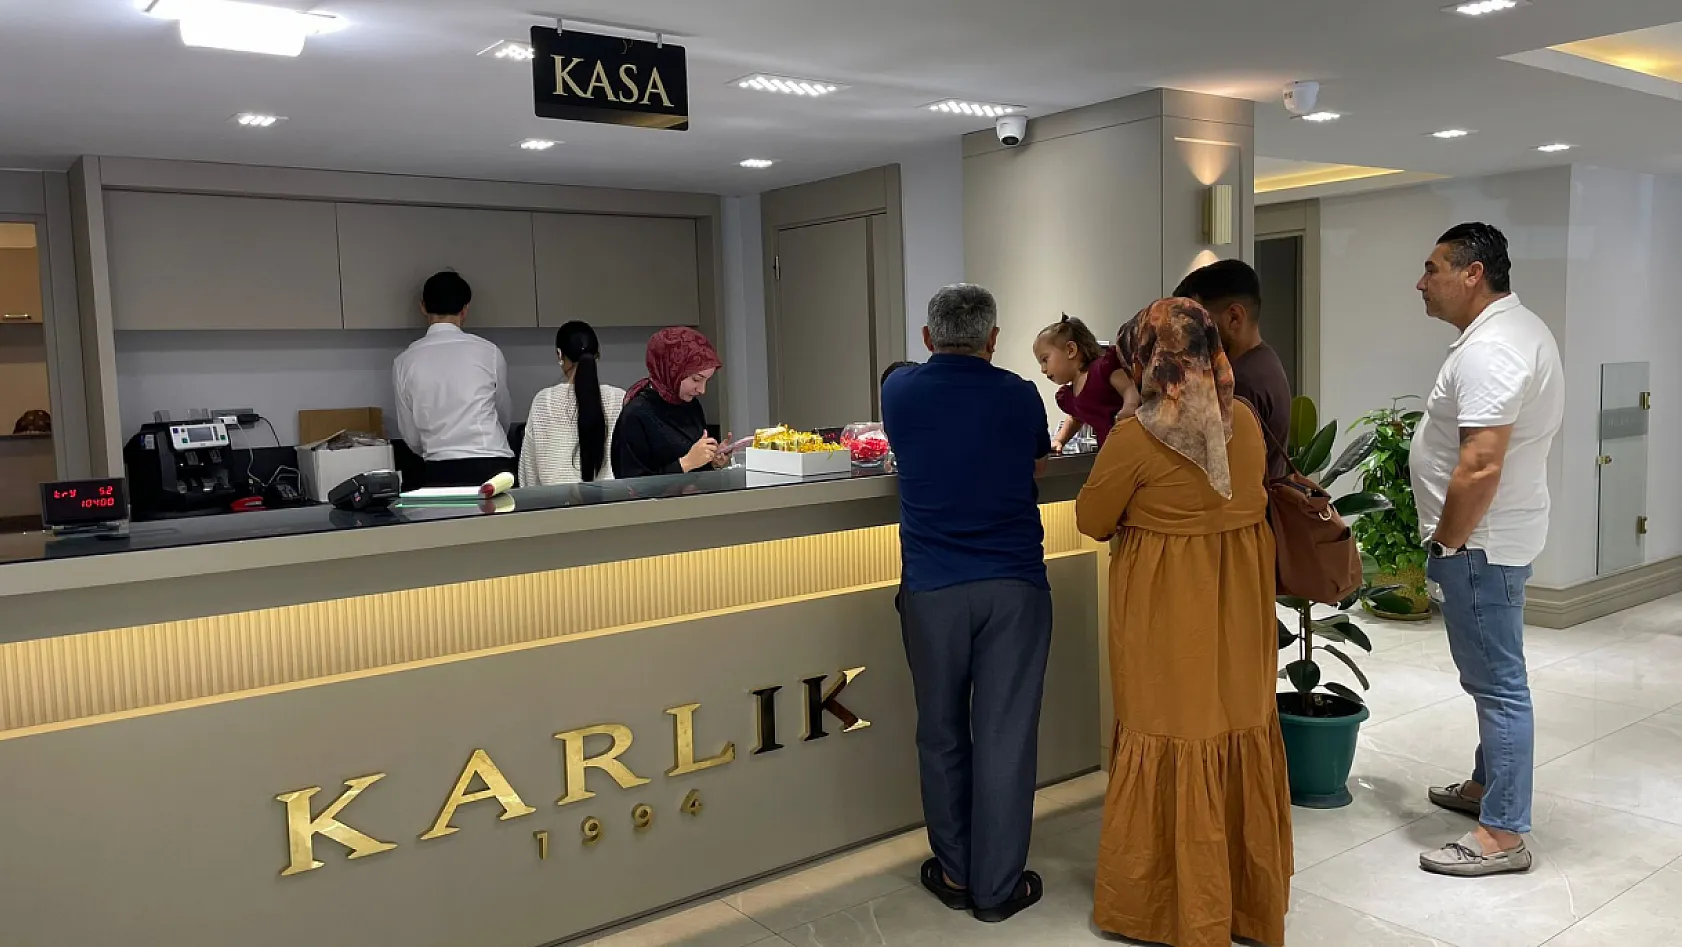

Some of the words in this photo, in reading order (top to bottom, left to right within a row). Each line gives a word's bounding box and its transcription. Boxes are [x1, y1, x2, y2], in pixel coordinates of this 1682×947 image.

[551, 54, 675, 107] KASA
[81, 497, 115, 508] 10400
[275, 666, 872, 876] KARLIK
[532, 788, 704, 860] 1994
